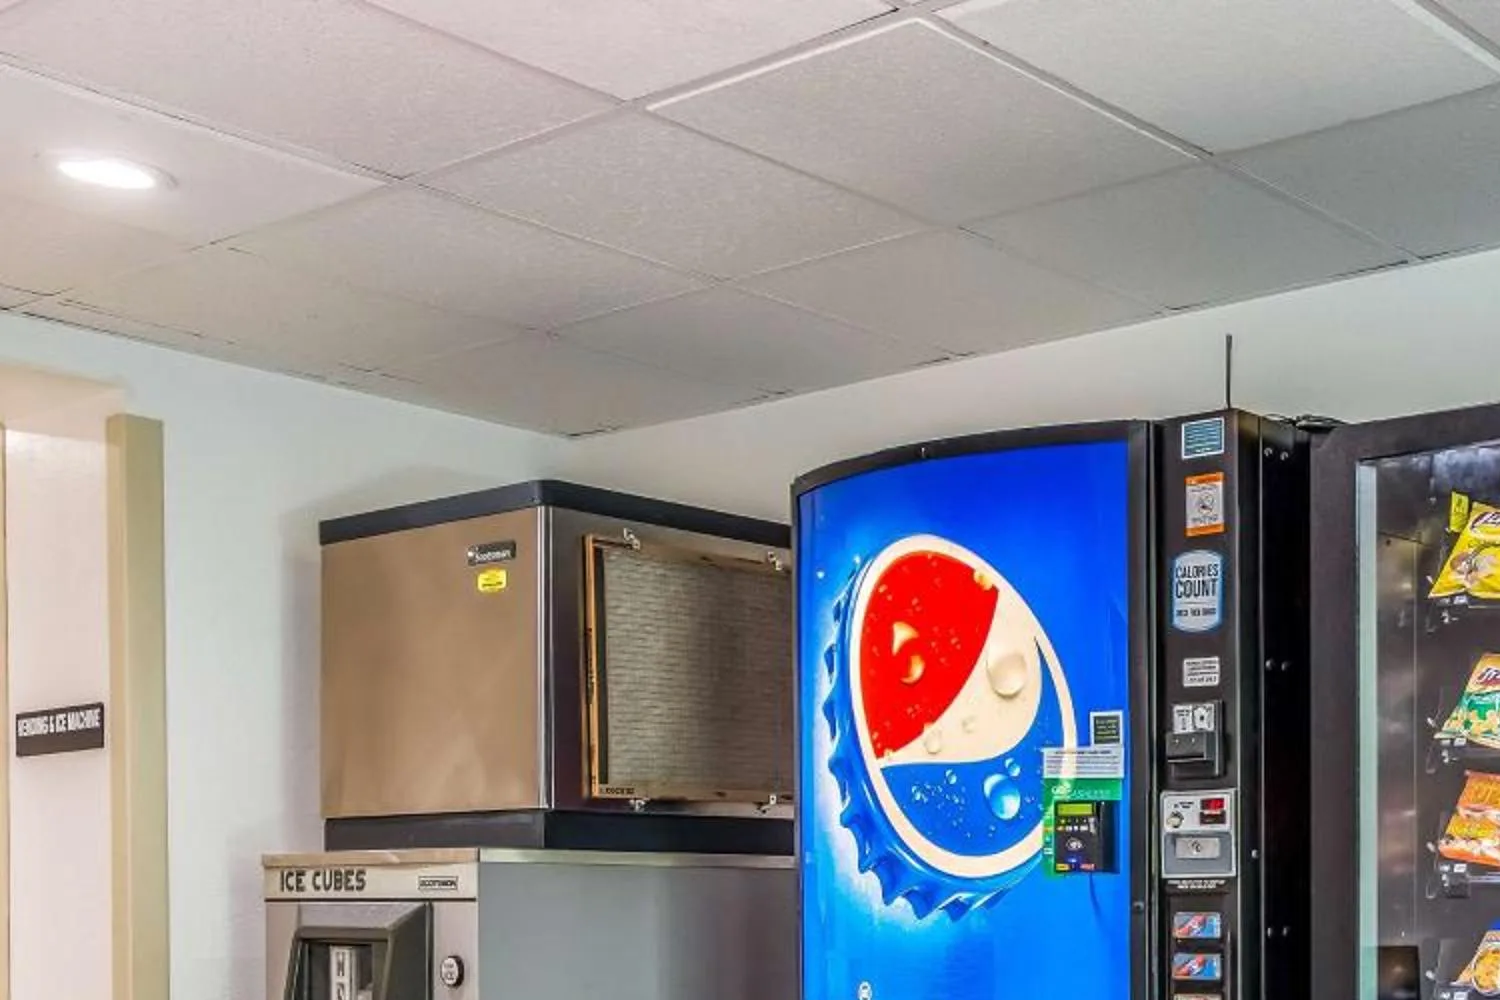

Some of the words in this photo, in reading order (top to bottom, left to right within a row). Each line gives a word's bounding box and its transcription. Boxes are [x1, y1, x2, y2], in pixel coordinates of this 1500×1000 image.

[1175, 578, 1219, 599] COUNT
[279, 870, 307, 893] ICE
[311, 869, 367, 892] CUBES
